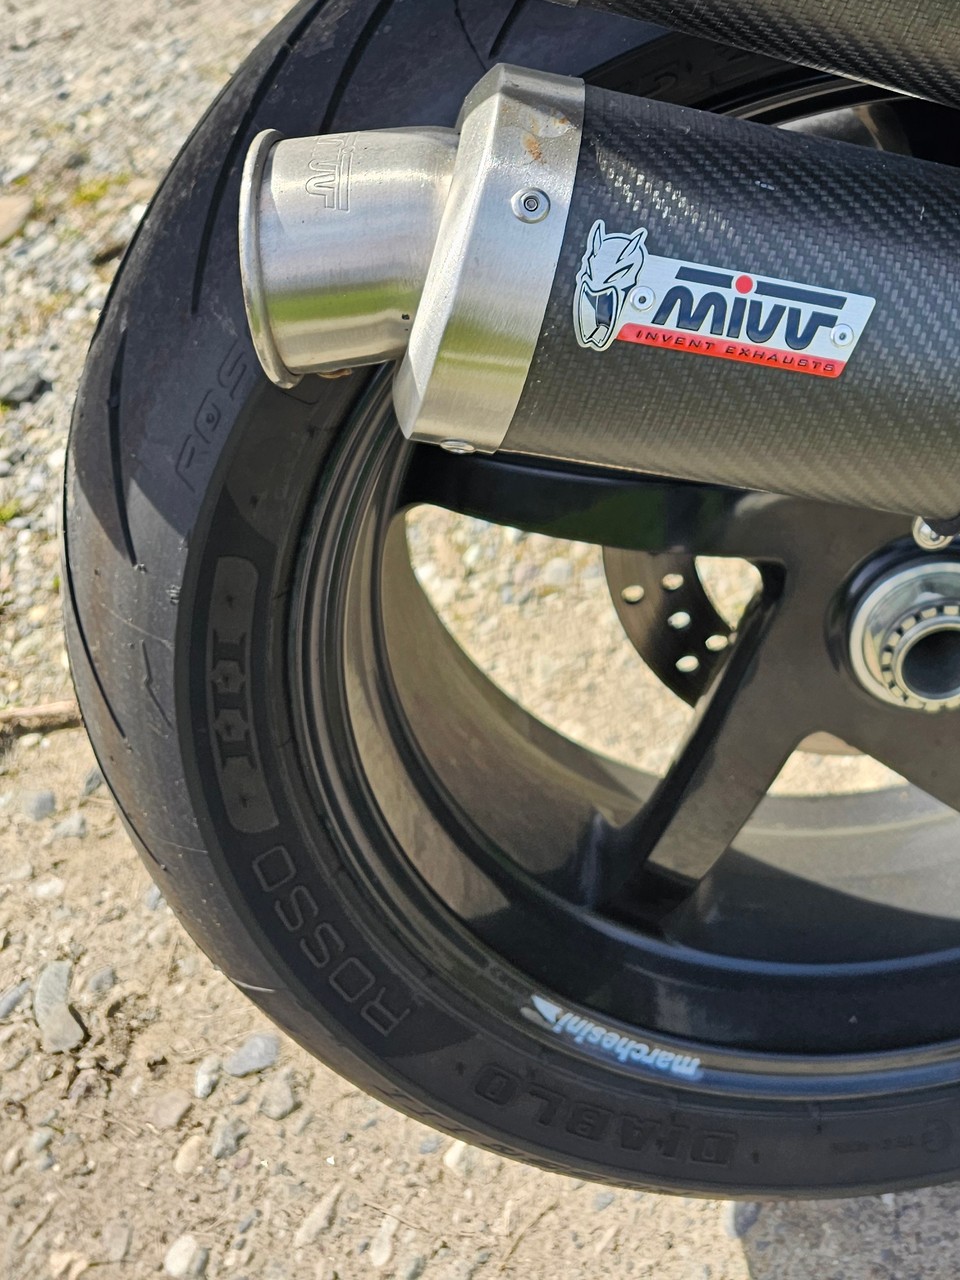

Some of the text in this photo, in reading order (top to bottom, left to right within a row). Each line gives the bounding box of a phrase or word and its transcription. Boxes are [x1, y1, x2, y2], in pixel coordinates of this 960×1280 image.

[635, 329, 836, 373] INVENT EXHAUSTS
[252, 844, 411, 1038] ROSSO
[552, 1011, 702, 1077] marchesini
[474, 1065, 740, 1168] DIABLO
